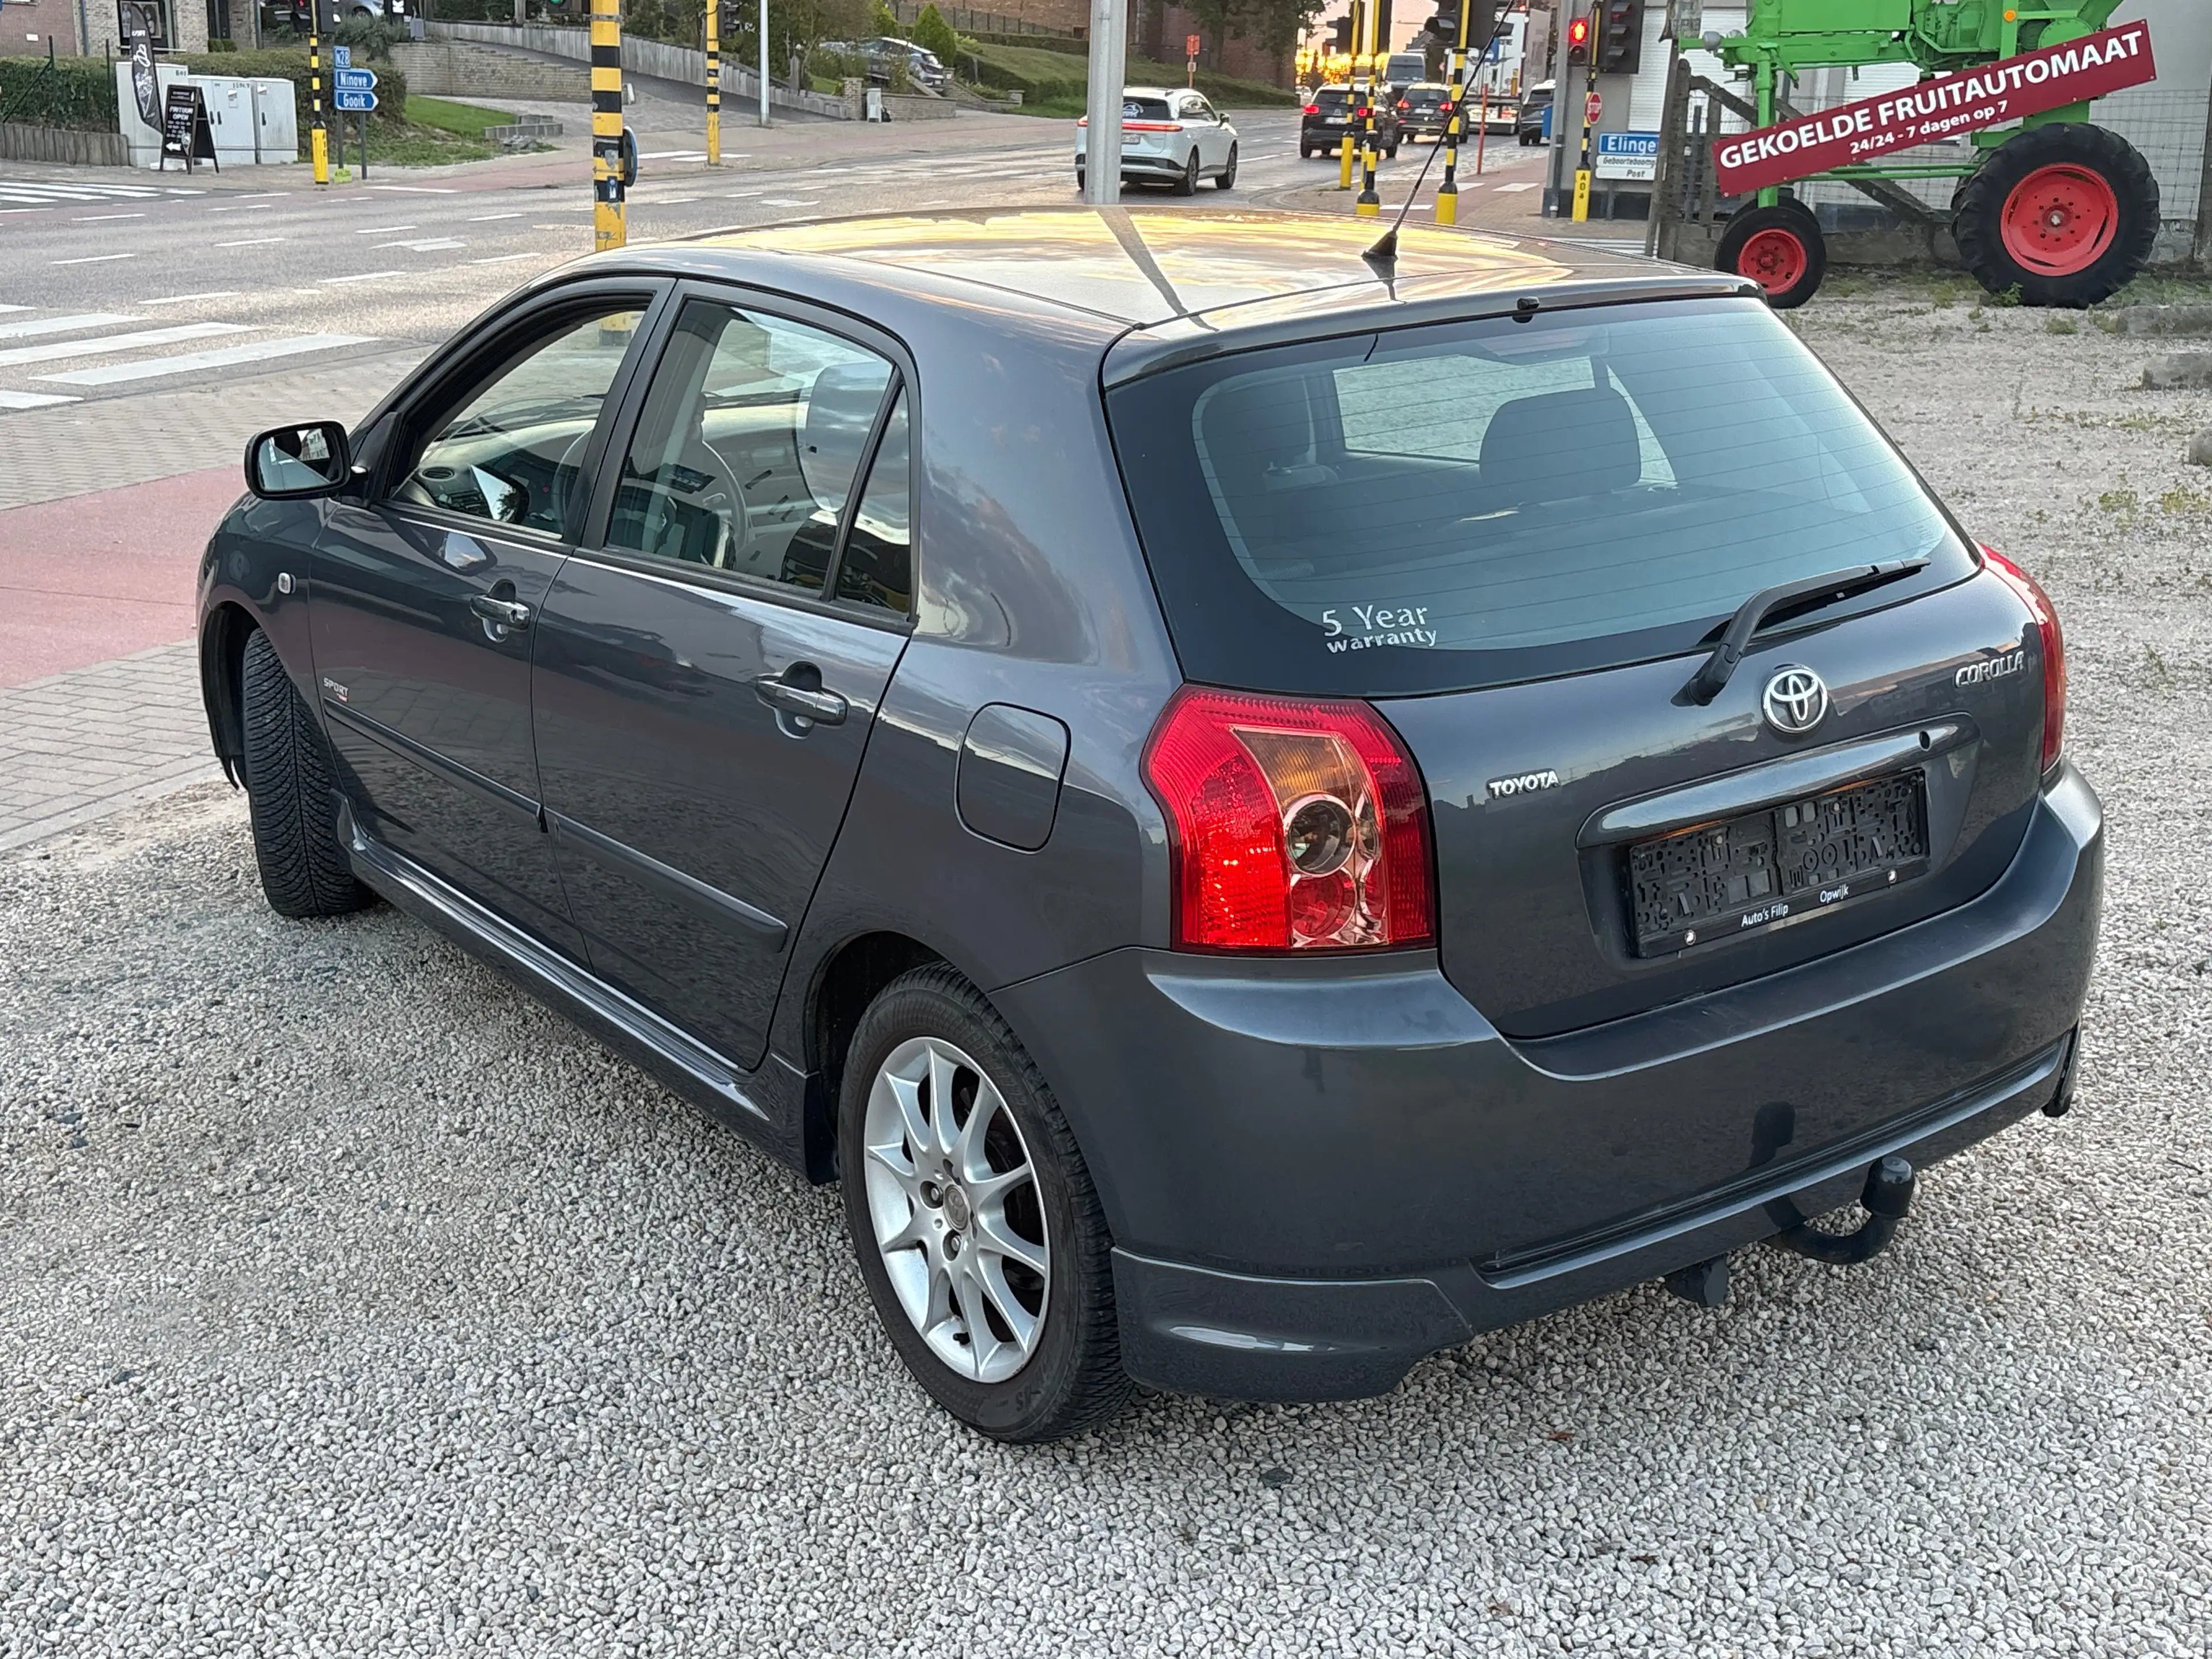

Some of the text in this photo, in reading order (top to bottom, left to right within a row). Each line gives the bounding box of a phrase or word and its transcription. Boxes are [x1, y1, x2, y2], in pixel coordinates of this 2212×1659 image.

[336, 51, 350, 65] N28
[340, 71, 368, 86] Ninove
[343, 93, 366, 107] Gooik
[1588, 103, 1601, 113] STOP
[1720, 30, 2143, 169] GEKOELDE FRUITAUTOMAAT
[1849, 131, 1895, 154] 24/24
[1906, 126, 1916, 139] 7
[1919, 111, 1970, 135] dagen
[1975, 107, 1995, 120] op
[1997, 100, 2009, 114] 7
[1607, 136, 1657, 154] Elinge
[1626, 169, 1646, 178] Post
[1322, 604, 1428, 637] 5 Year
[1326, 628, 1438, 654] warranty
[1955, 650, 2025, 688] COROLLA
[323, 677, 349, 696] SPORT
[1488, 770, 1560, 800] TOYOTA
[1741, 883, 1850, 928] Auto's Filip Opwijk
